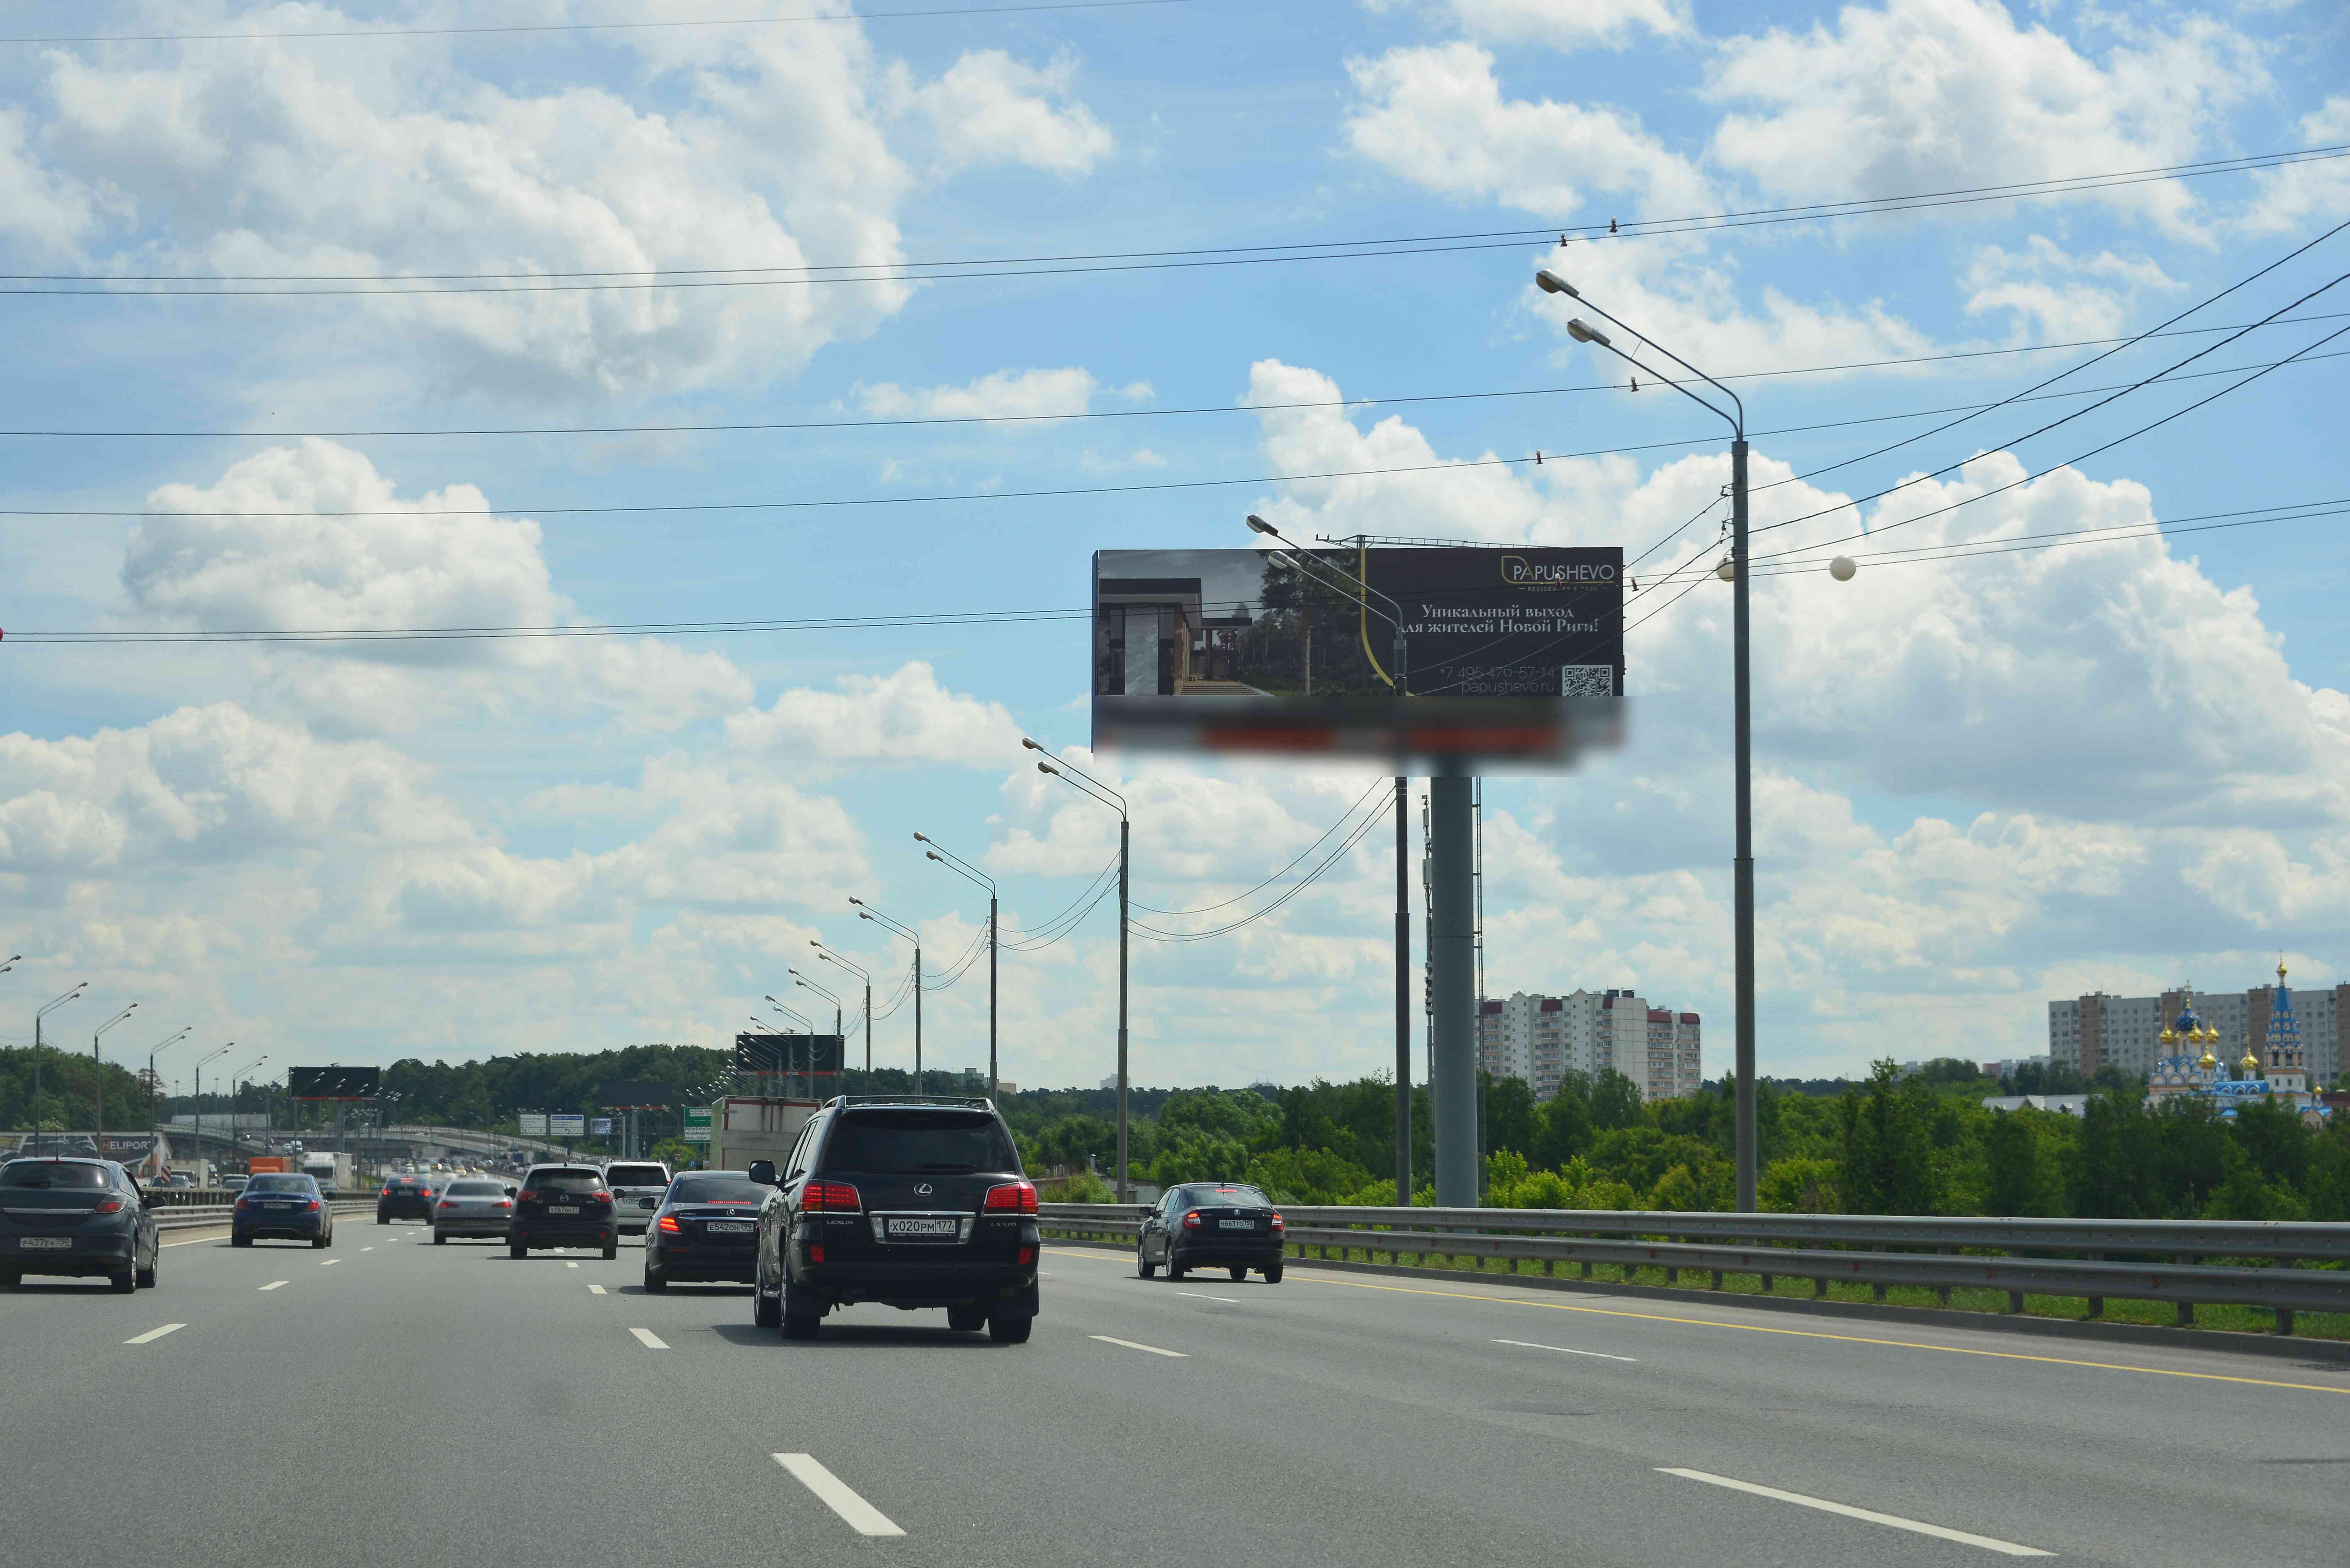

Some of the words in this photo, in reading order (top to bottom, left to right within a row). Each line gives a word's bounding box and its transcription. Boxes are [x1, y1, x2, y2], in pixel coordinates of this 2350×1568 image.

[1514, 565, 1614, 580] PAPUSHEVO
[1422, 604, 1520, 617] Уникальный
[1526, 608, 1574, 618] выход
[1428, 620, 1494, 632] жителей
[1499, 619, 1551, 632] Новой
[1556, 619, 1598, 632] Риги!
[1440, 667, 1453, 679] +7
[1457, 667, 1483, 679] 495
[1461, 680, 1554, 695] papushevo.ru
[892, 1221, 934, 1232] Х020РМ
[936, 1221, 952, 1229] 177
